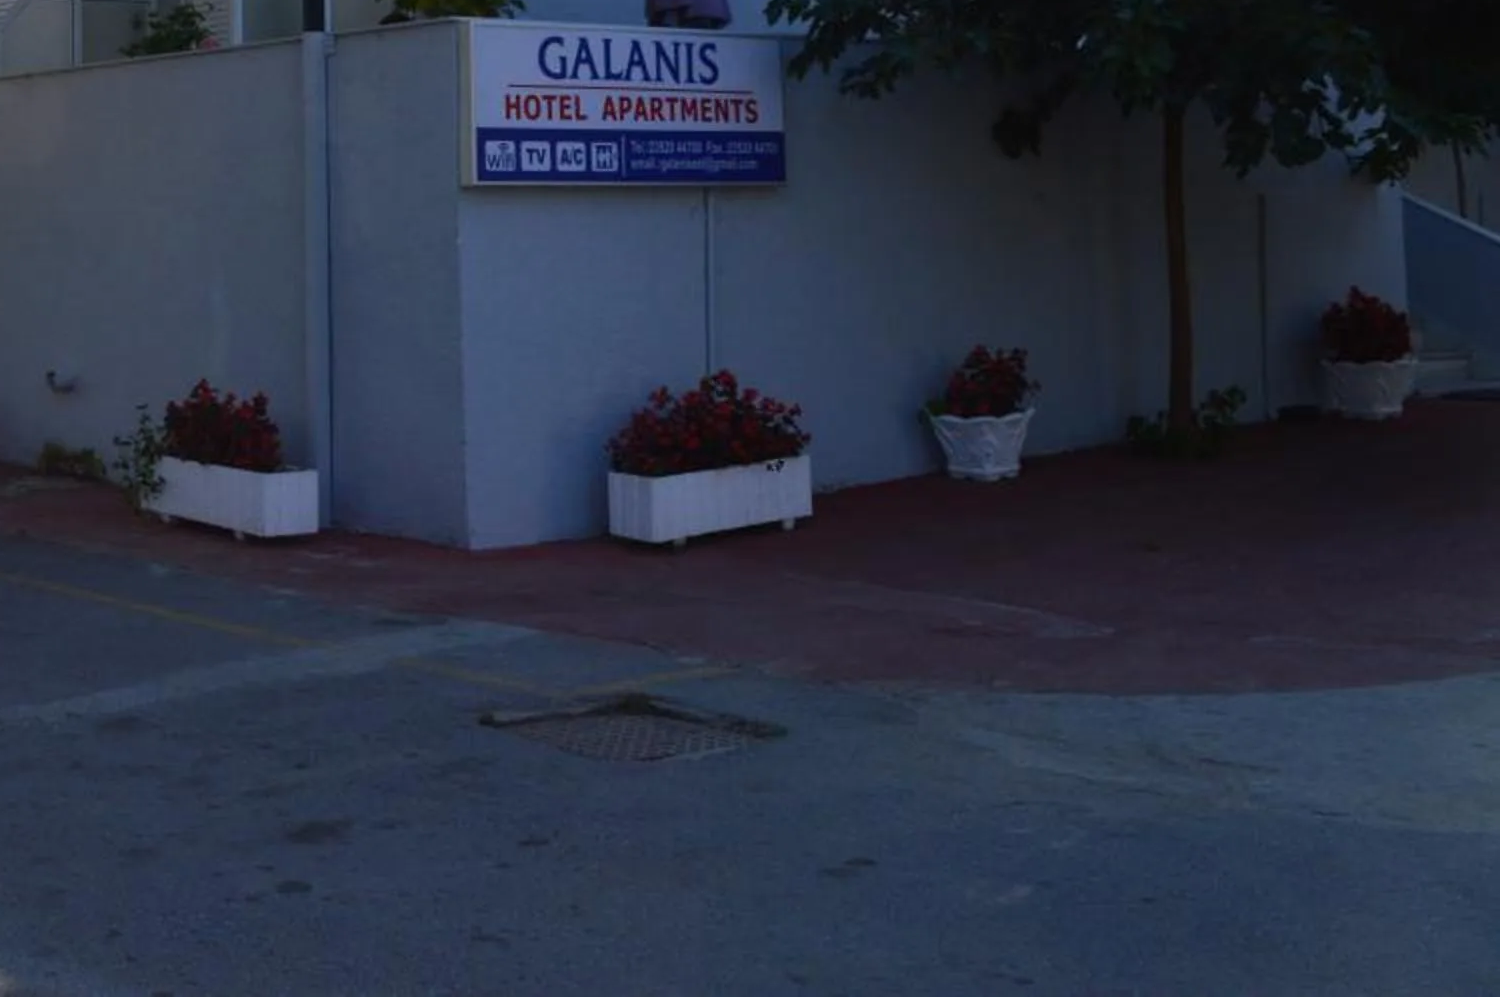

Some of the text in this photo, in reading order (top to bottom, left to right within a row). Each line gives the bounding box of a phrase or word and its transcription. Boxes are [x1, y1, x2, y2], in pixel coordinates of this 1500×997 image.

[537, 35, 720, 86] GALANIS
[504, 93, 759, 124] HOTEL APARTMENTS
[525, 148, 547, 166] TV
